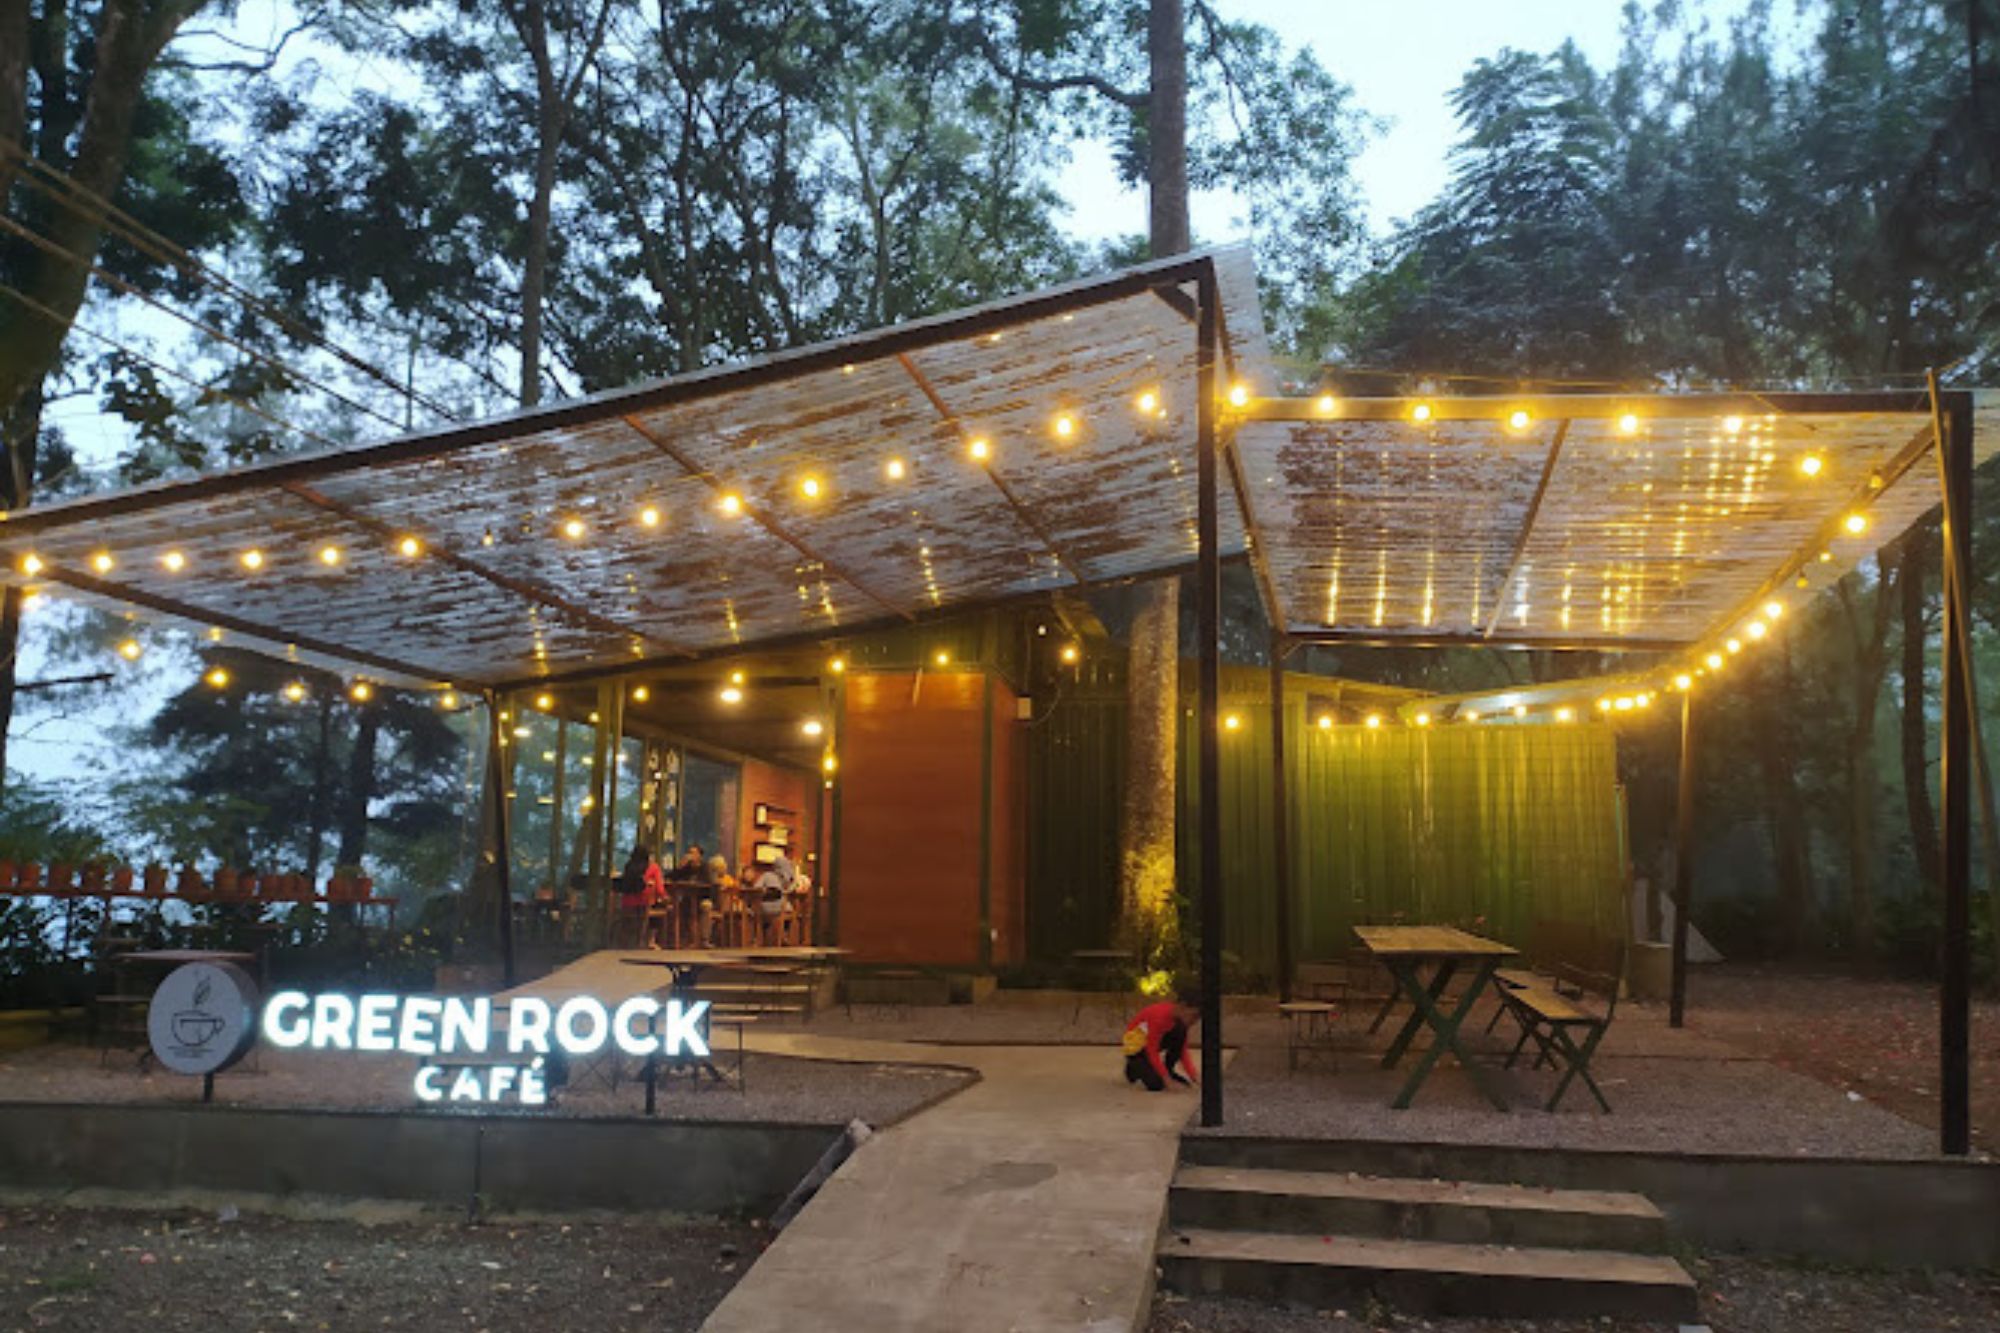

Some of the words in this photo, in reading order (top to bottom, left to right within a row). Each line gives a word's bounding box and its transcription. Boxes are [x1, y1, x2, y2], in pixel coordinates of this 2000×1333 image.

[262, 990, 489, 1054] GREEN
[507, 996, 711, 1057] ROCK
[414, 1057, 547, 1104] CAFÉ
